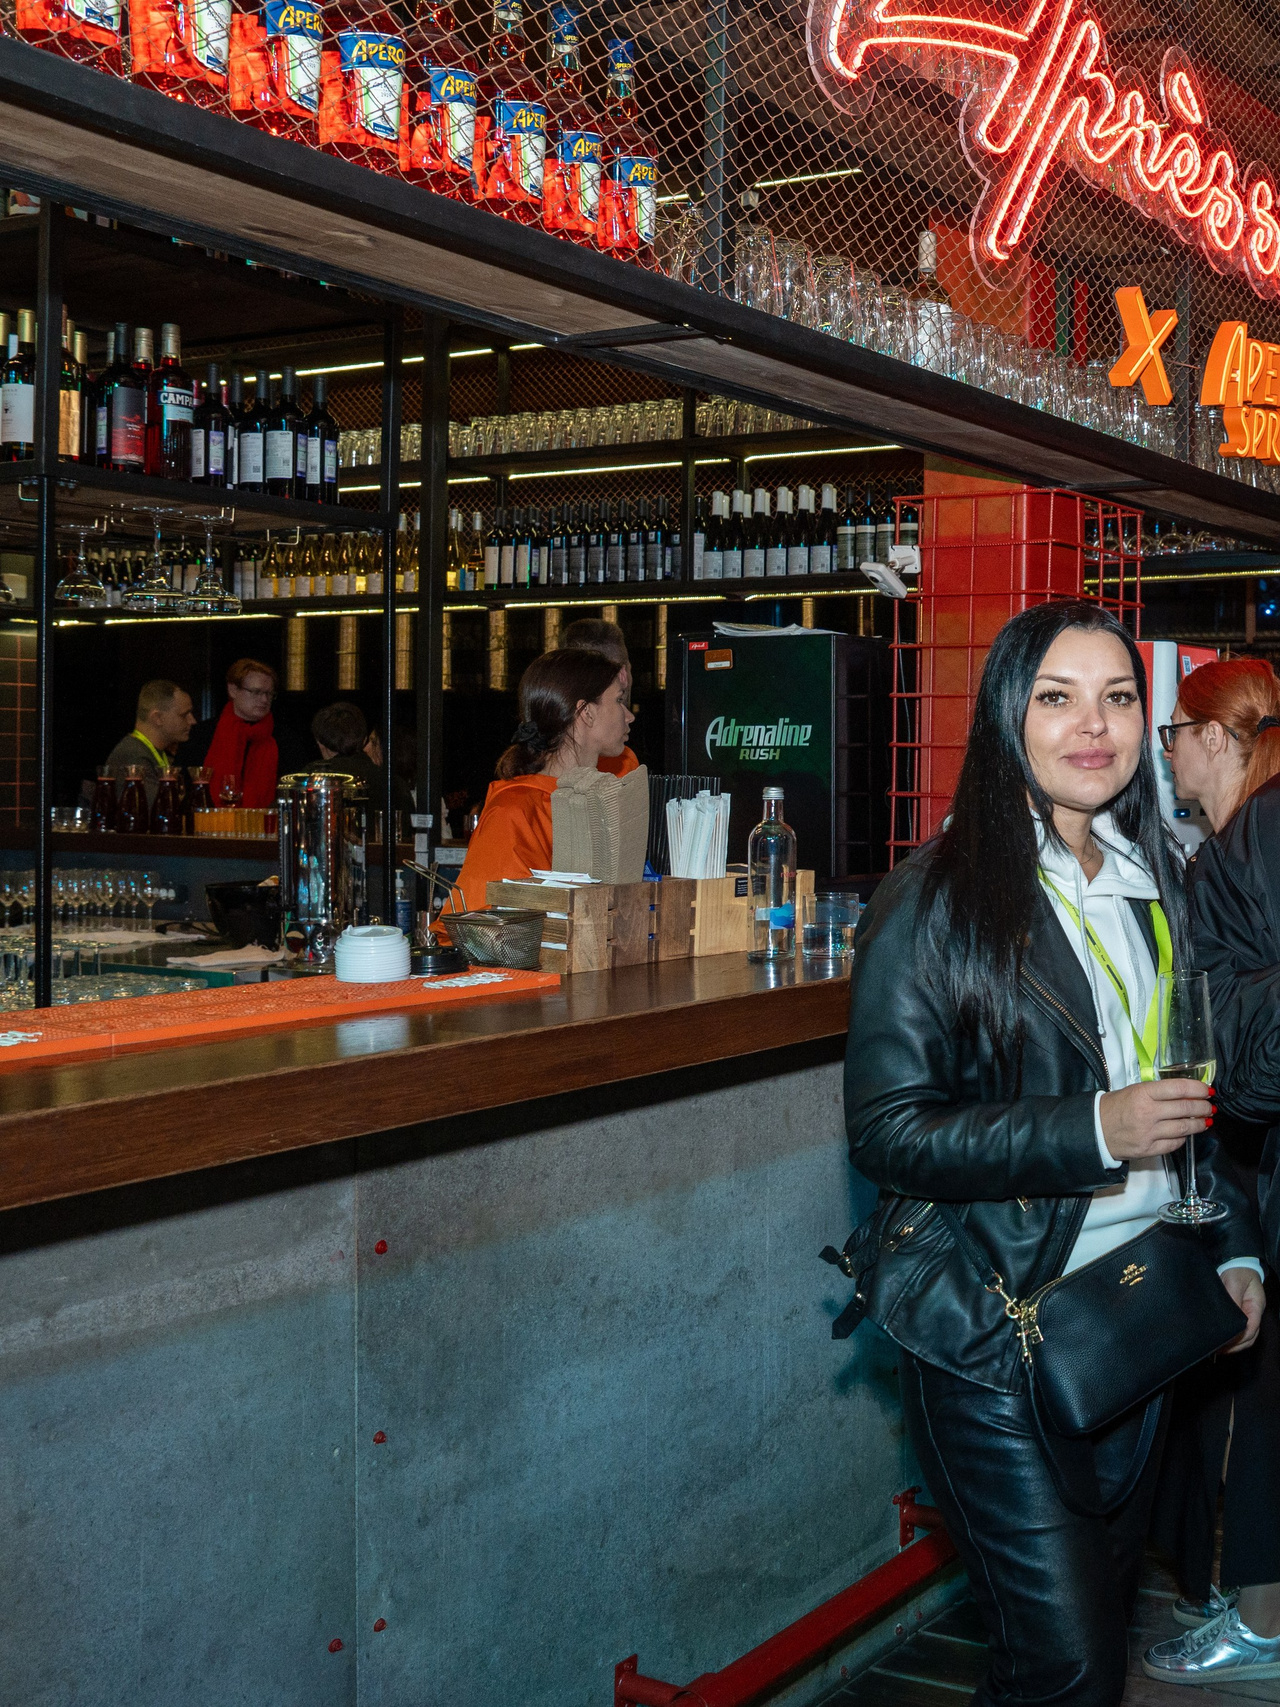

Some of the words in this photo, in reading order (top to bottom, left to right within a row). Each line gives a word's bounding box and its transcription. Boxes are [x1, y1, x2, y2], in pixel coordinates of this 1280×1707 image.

[278, 5, 323, 35] APER
[352, 39, 406, 65] APERO
[441, 75, 477, 100] APER
[705, 716, 813, 760] Adrenaline
[739, 748, 780, 760] RUSH
